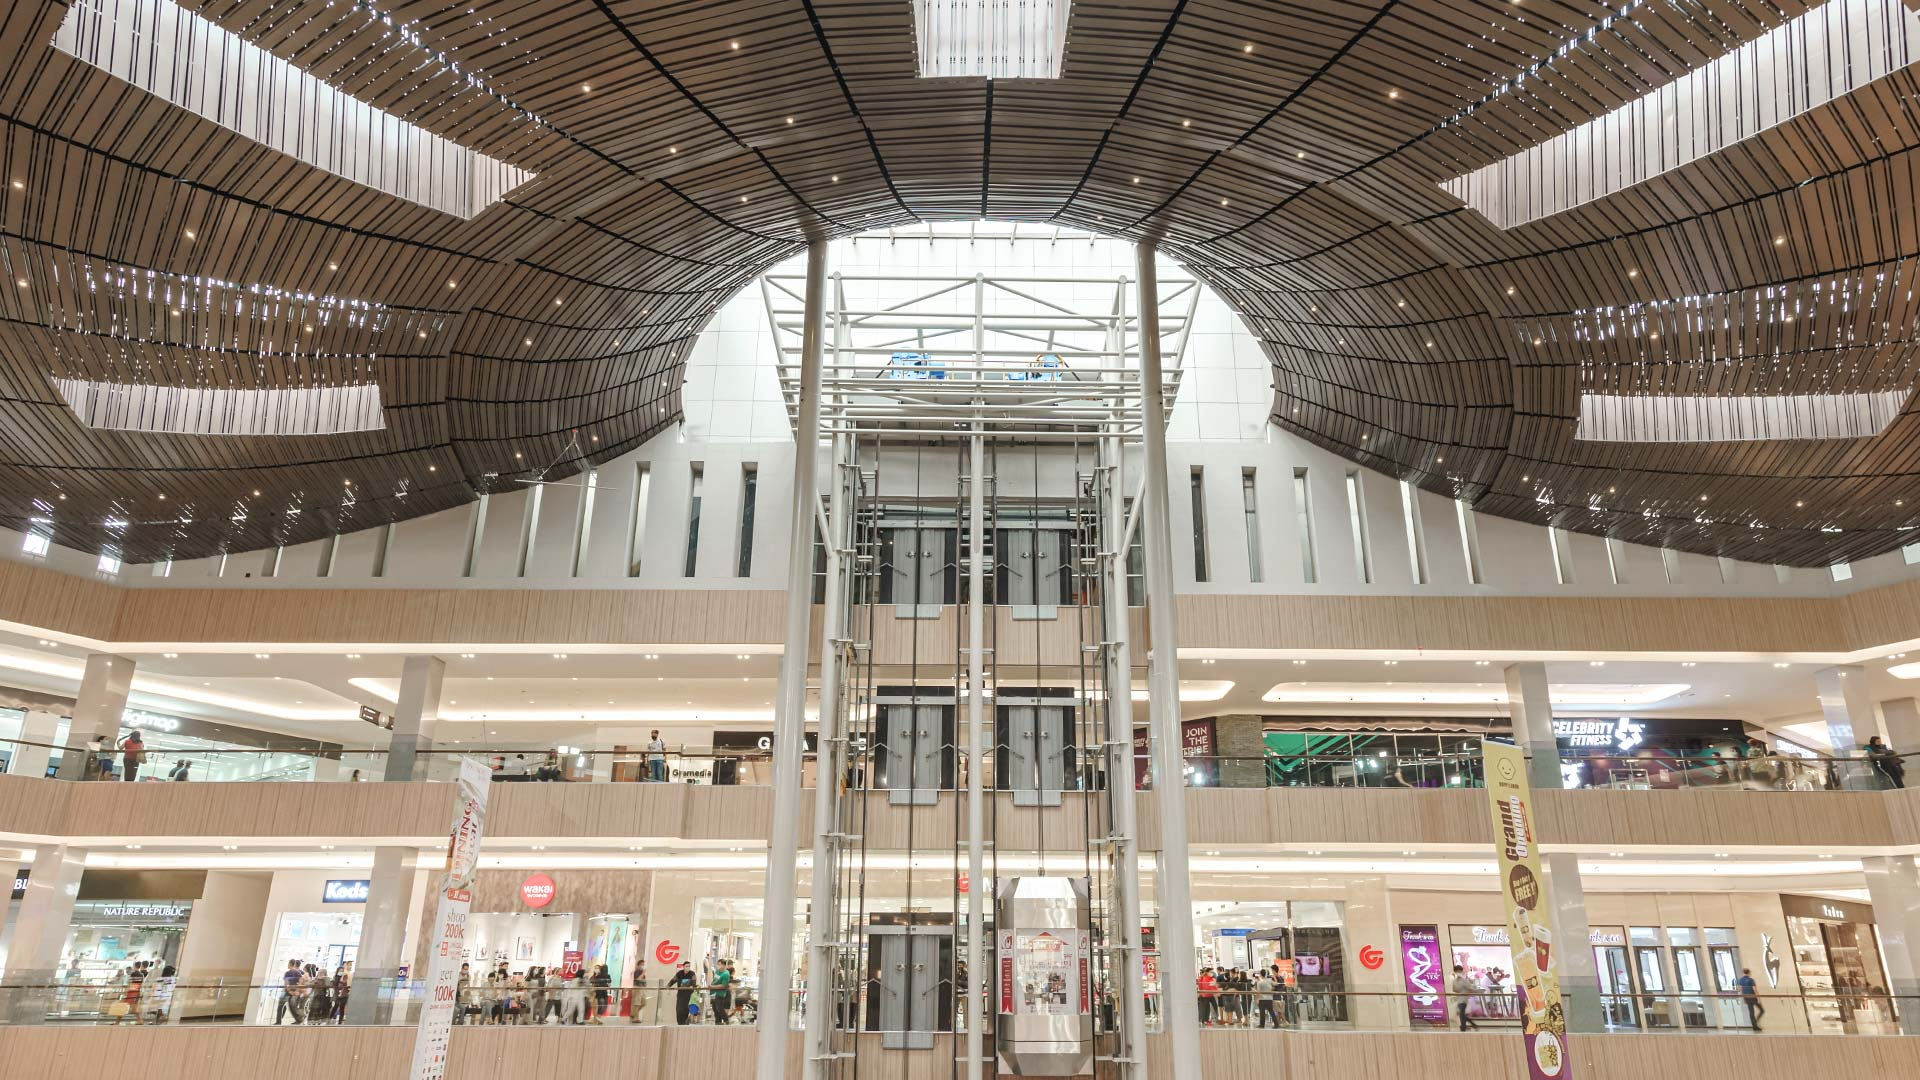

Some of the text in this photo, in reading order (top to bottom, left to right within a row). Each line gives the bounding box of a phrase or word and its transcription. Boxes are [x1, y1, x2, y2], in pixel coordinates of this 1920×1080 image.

[1186, 726, 1207, 738] JOIN
[1552, 721, 1615, 734] CELEBRITY
[1188, 735, 1208, 746] THE
[1570, 734, 1612, 746] FITNESS
[1182, 744, 1209, 756] TRIBE
[672, 769, 712, 777] Gramedia
[1497, 800, 1520, 861] Grand
[325, 881, 369, 899] Keds
[104, 907, 185, 916] NATURE REPUBLIC
[447, 908, 466, 924] shop
[445, 923, 465, 939] 200k
[434, 985, 455, 1001] 100k
